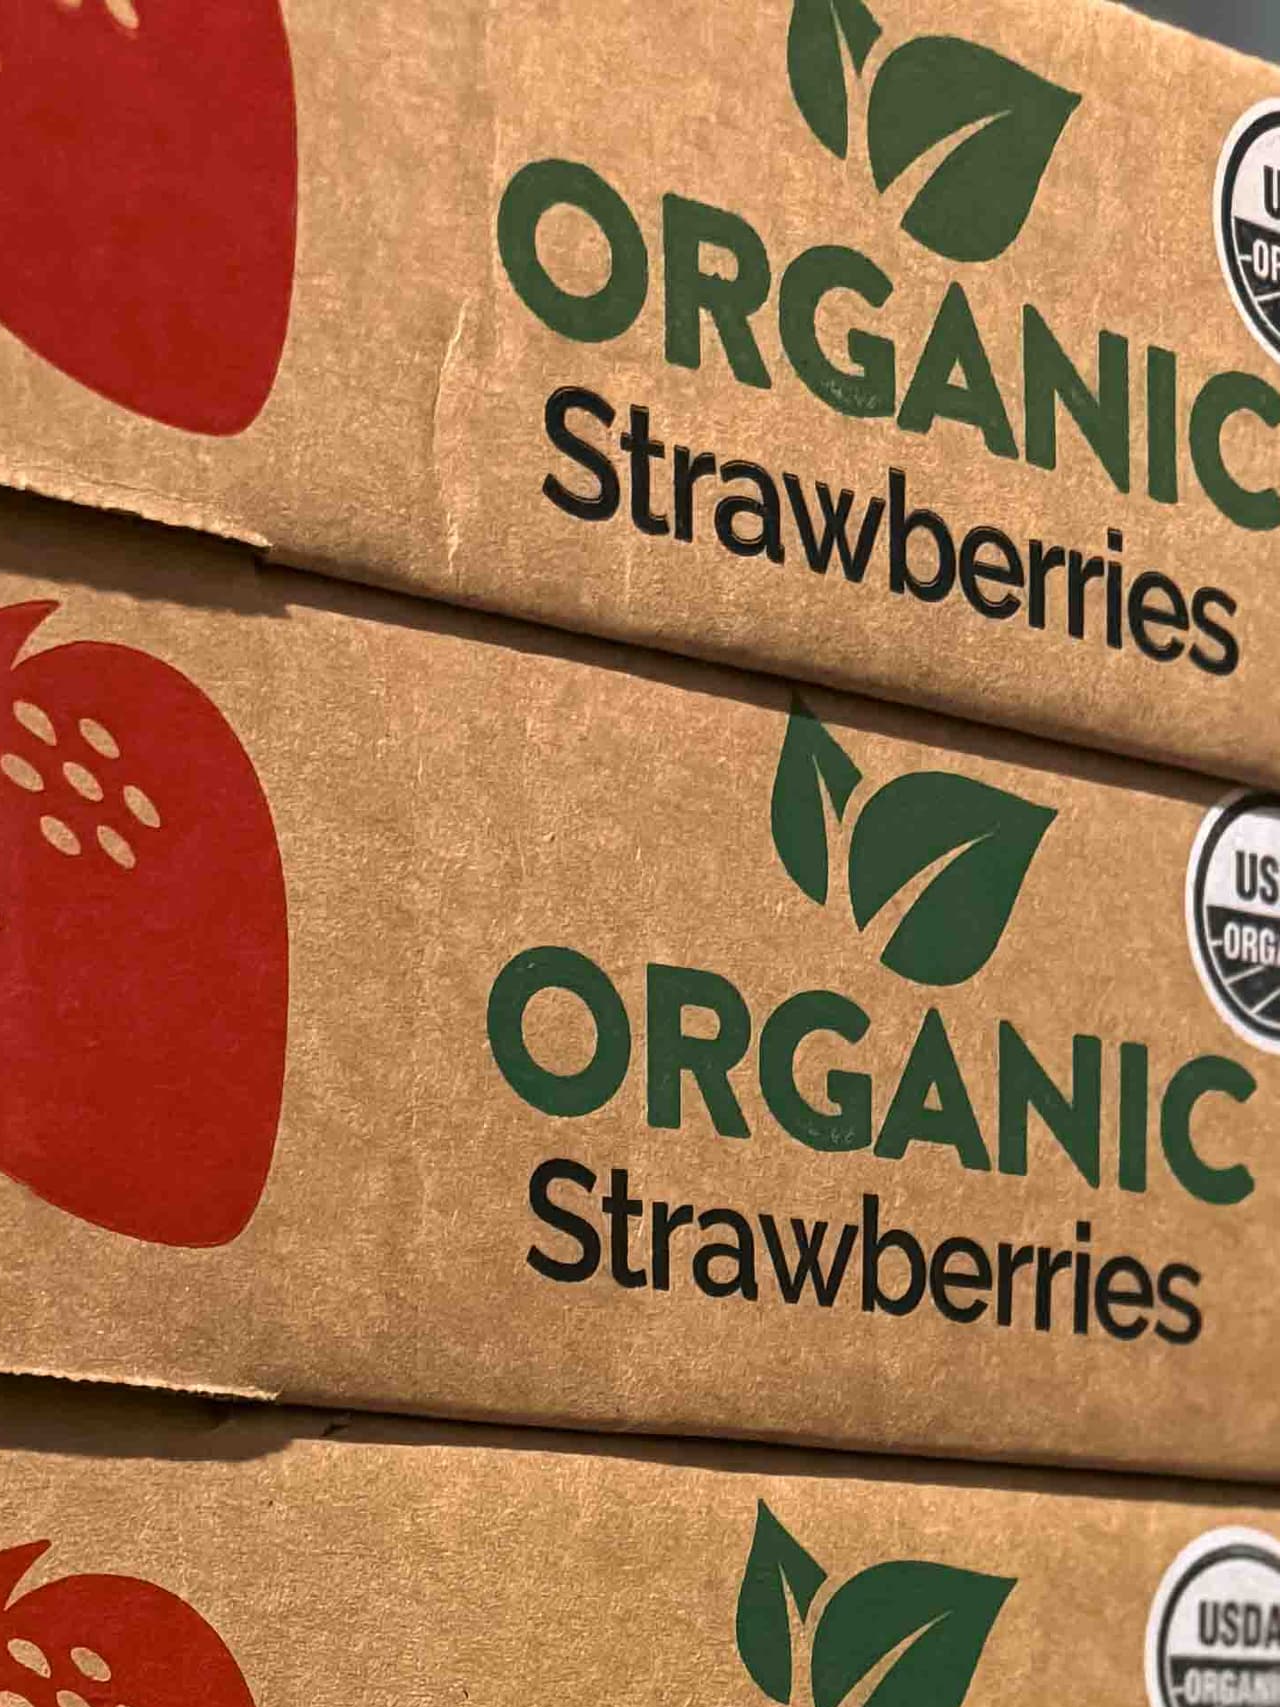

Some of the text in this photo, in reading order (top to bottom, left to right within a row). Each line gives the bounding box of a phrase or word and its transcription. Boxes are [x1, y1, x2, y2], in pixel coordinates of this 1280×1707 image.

[540, 385, 1242, 678] Strawberries
[485, 945, 1258, 1206] ORGANIC
[526, 1158, 1203, 1346] Strawberries
